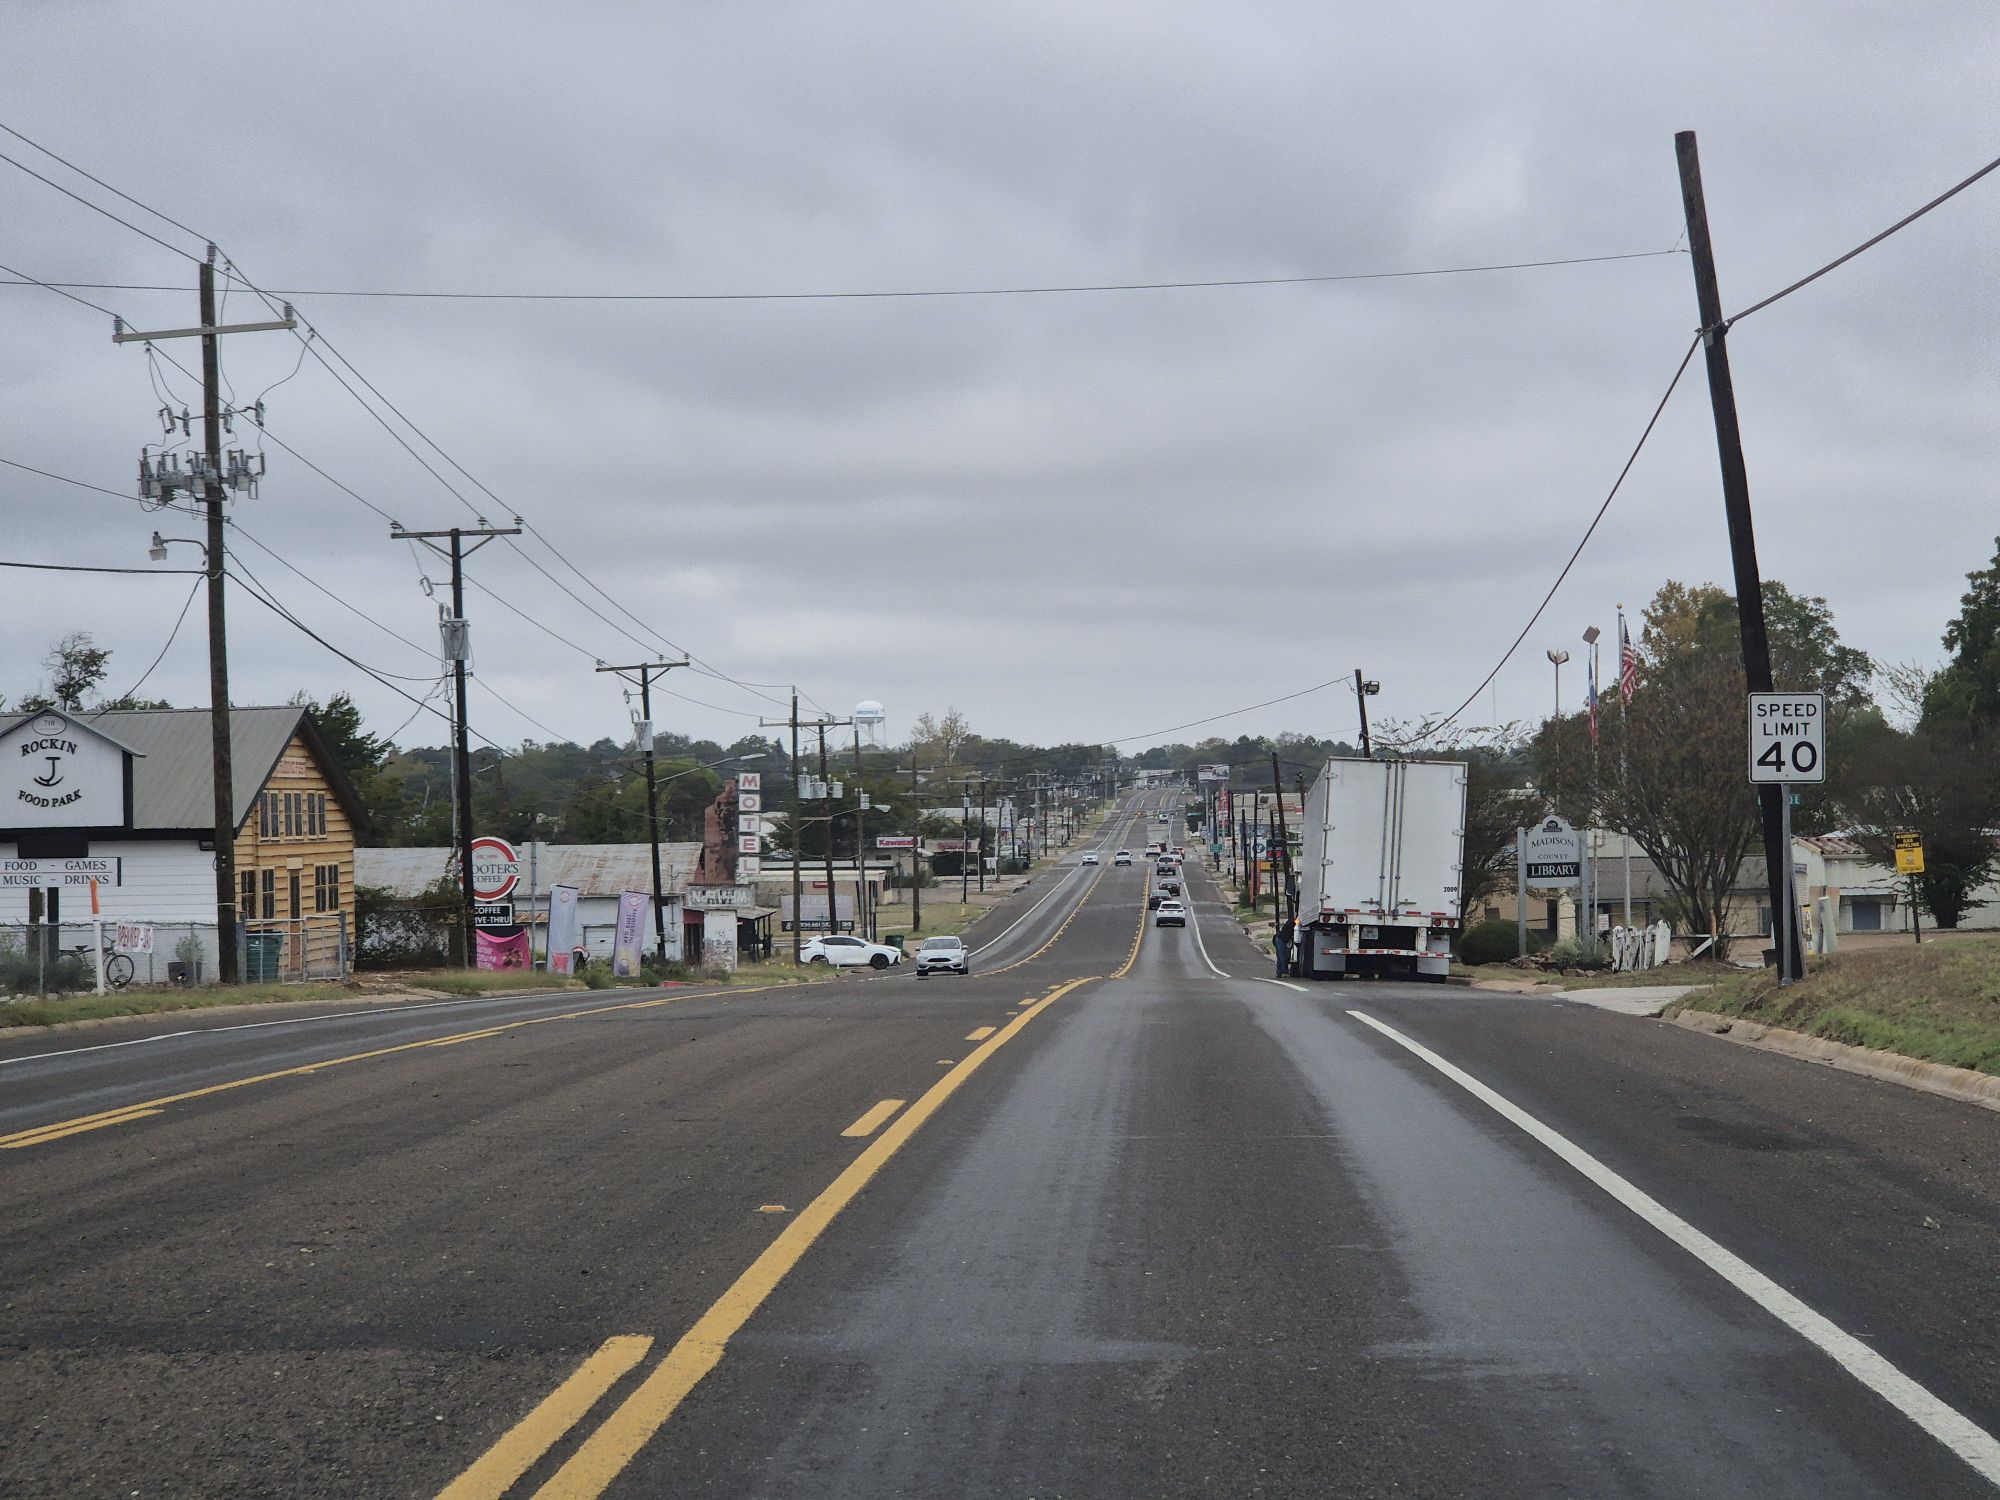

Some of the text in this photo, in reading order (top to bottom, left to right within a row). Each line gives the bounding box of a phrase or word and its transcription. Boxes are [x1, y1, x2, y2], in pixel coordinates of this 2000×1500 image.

[1757, 703, 1817, 717] SPEED
[1763, 722, 1810, 736] LIMIT
[21, 738, 77, 757] ROCKIN
[1757, 741, 1817, 773] 40
[18, 789, 82, 807] FOOD PARK
[742, 775, 758, 872] MOTEL
[1531, 837, 1574, 848] MADISON
[5, 861, 37, 871] FOOD
[65, 860, 107, 871] GAMES
[1531, 864, 1577, 876] LIBRARY
[3, 875, 41, 885] MUSIC
[474, 916, 510, 924] IVE-THRU
